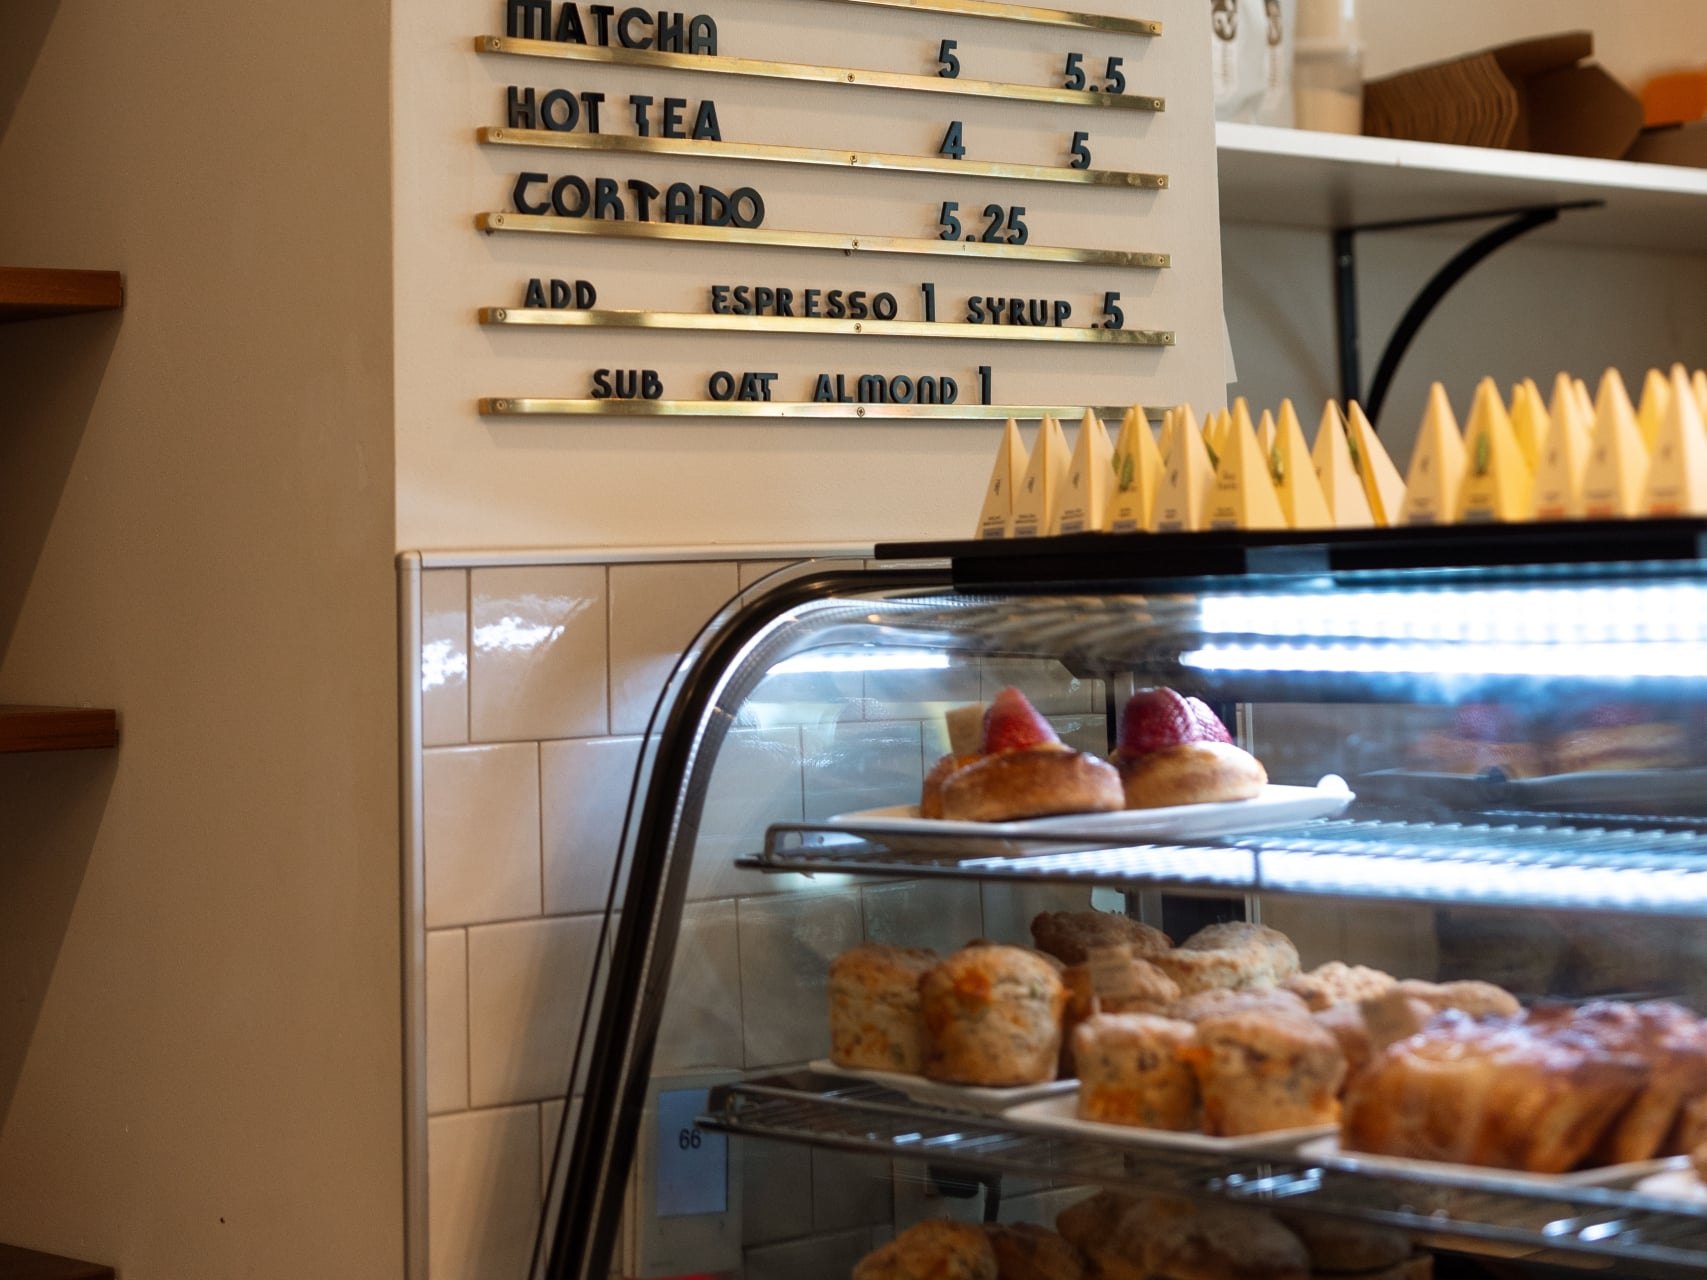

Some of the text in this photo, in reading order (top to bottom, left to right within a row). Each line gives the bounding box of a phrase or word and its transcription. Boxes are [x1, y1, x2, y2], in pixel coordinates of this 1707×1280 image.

[938, 40, 960, 78] 5
[1065, 53, 1126, 94] 5.5
[508, 86, 1091, 169] HOT TEA 4 5
[513, 172, 1028, 245] CORTADO 5.25
[525, 279, 596, 309] ADD
[712, 285, 898, 320] ESPRESSO
[922, 283, 936, 322] 1
[967, 296, 1072, 327] SYRUP
[591, 369, 663, 399] SUB
[709, 371, 778, 401] OAT
[979, 366, 992, 405] 1
